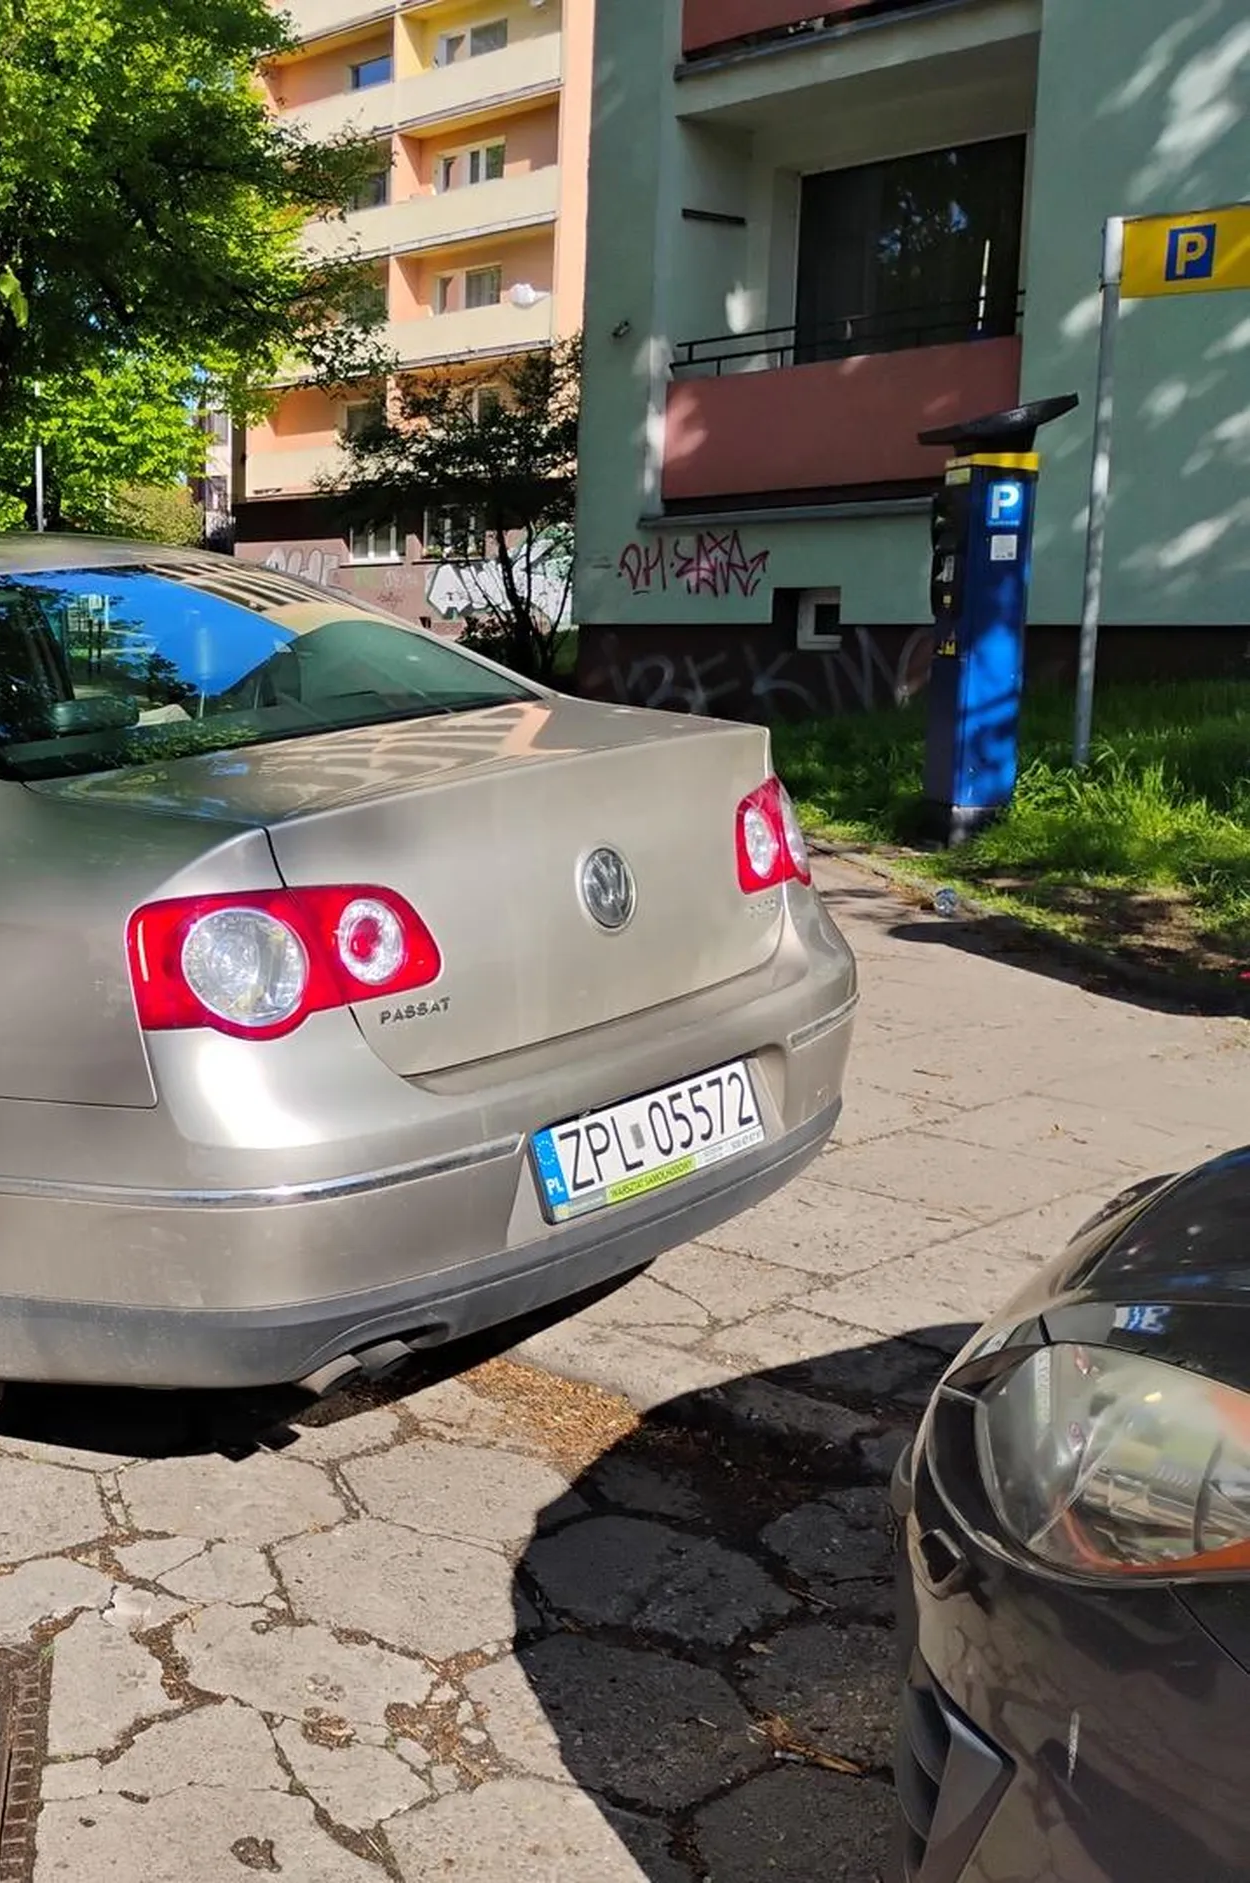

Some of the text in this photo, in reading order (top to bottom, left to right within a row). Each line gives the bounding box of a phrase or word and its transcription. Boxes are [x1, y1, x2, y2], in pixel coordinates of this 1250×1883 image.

[1175, 231, 1208, 277] P
[990, 485, 1020, 519] P
[379, 997, 451, 1025] PASSAT
[558, 1115, 644, 1192] ZPL
[648, 1071, 754, 1156] 05572
[546, 1179, 564, 1195] PL
